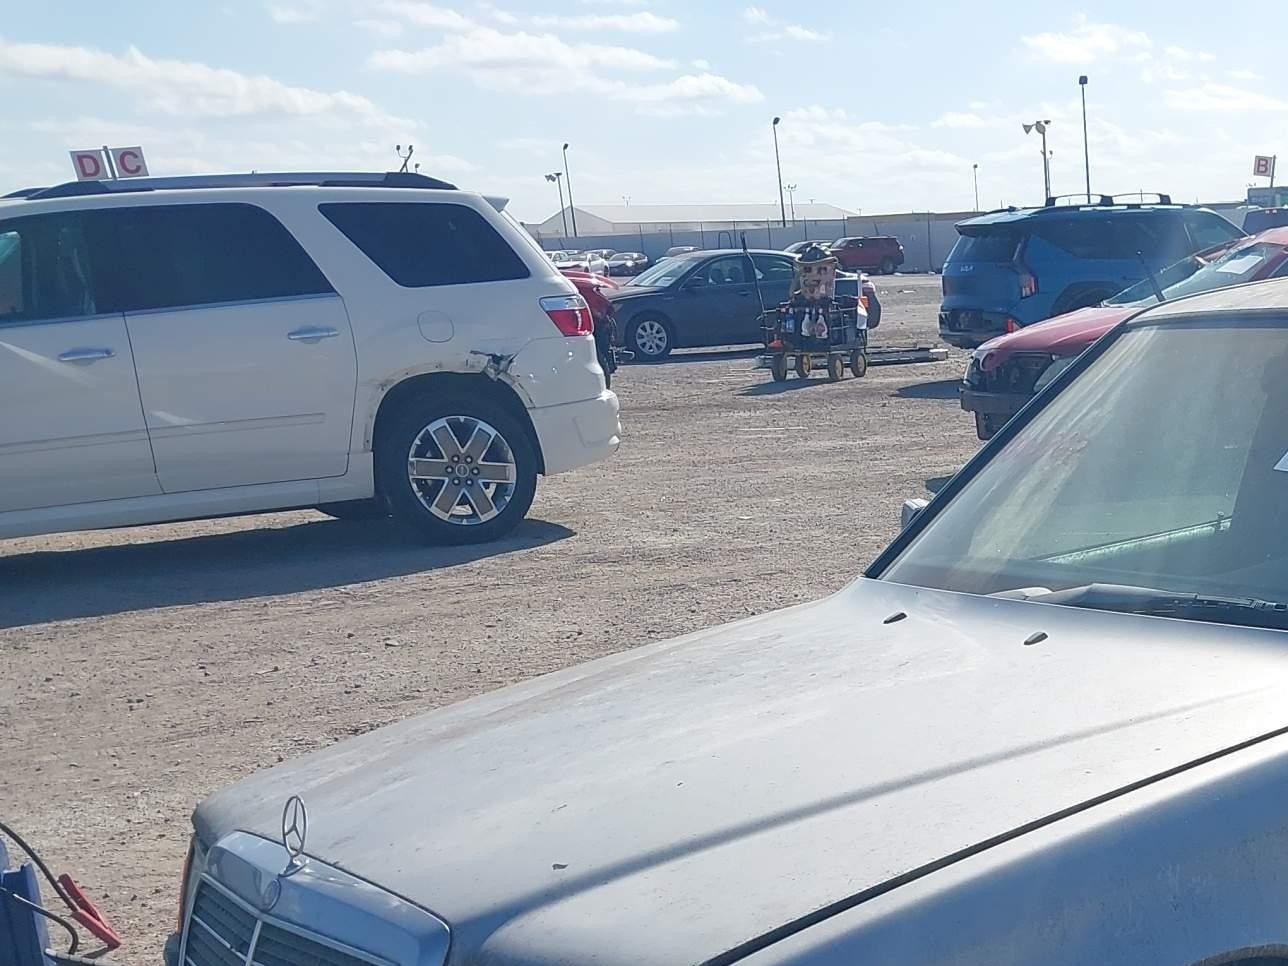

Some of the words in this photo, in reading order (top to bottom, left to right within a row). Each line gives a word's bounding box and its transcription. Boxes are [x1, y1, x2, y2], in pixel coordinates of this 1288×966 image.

[77, 154, 100, 177] D
[120, 151, 142, 174] C
[1256, 158, 1269, 174] B
